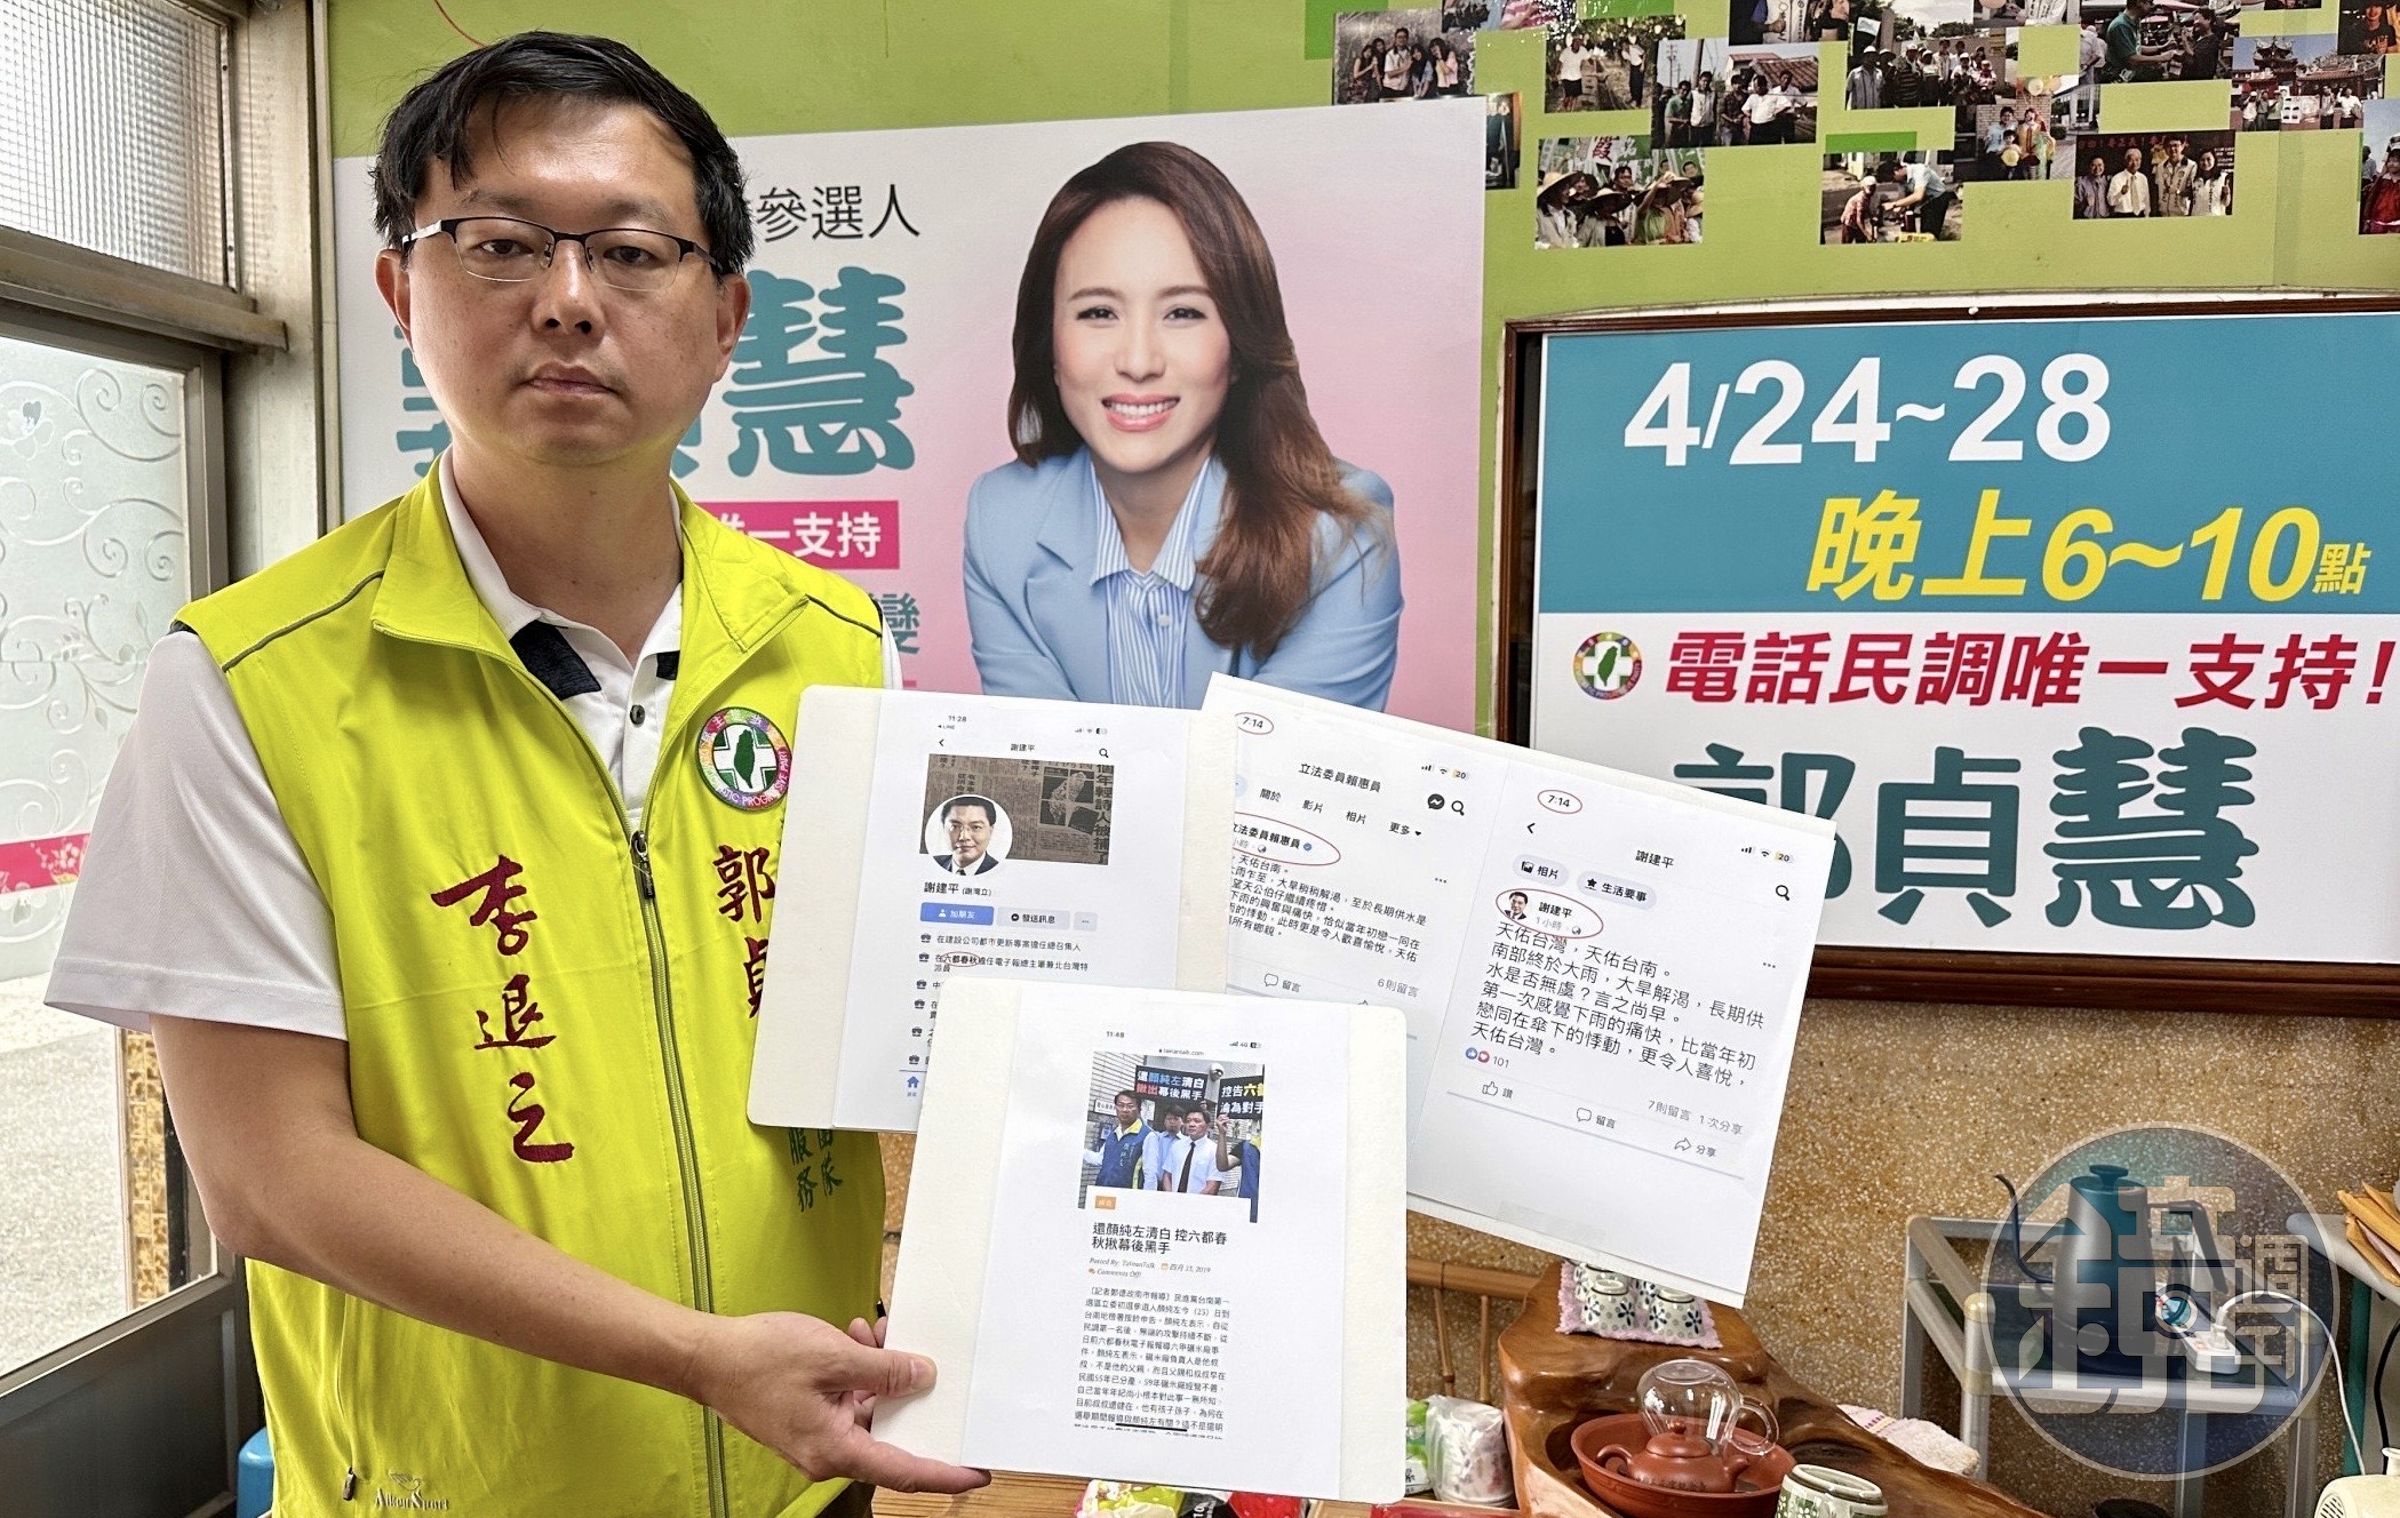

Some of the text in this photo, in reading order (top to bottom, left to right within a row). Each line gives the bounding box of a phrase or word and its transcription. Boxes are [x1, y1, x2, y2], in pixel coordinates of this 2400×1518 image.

[756, 182, 921, 243] 參選人
[1624, 353, 2111, 467] 4/24~28
[1806, 489, 2373, 603] 晚上6~10點
[1242, 716, 1264, 730] 7:14
[1547, 794, 1571, 808] 7:14
[1635, 848, 1675, 870] 謝建平
